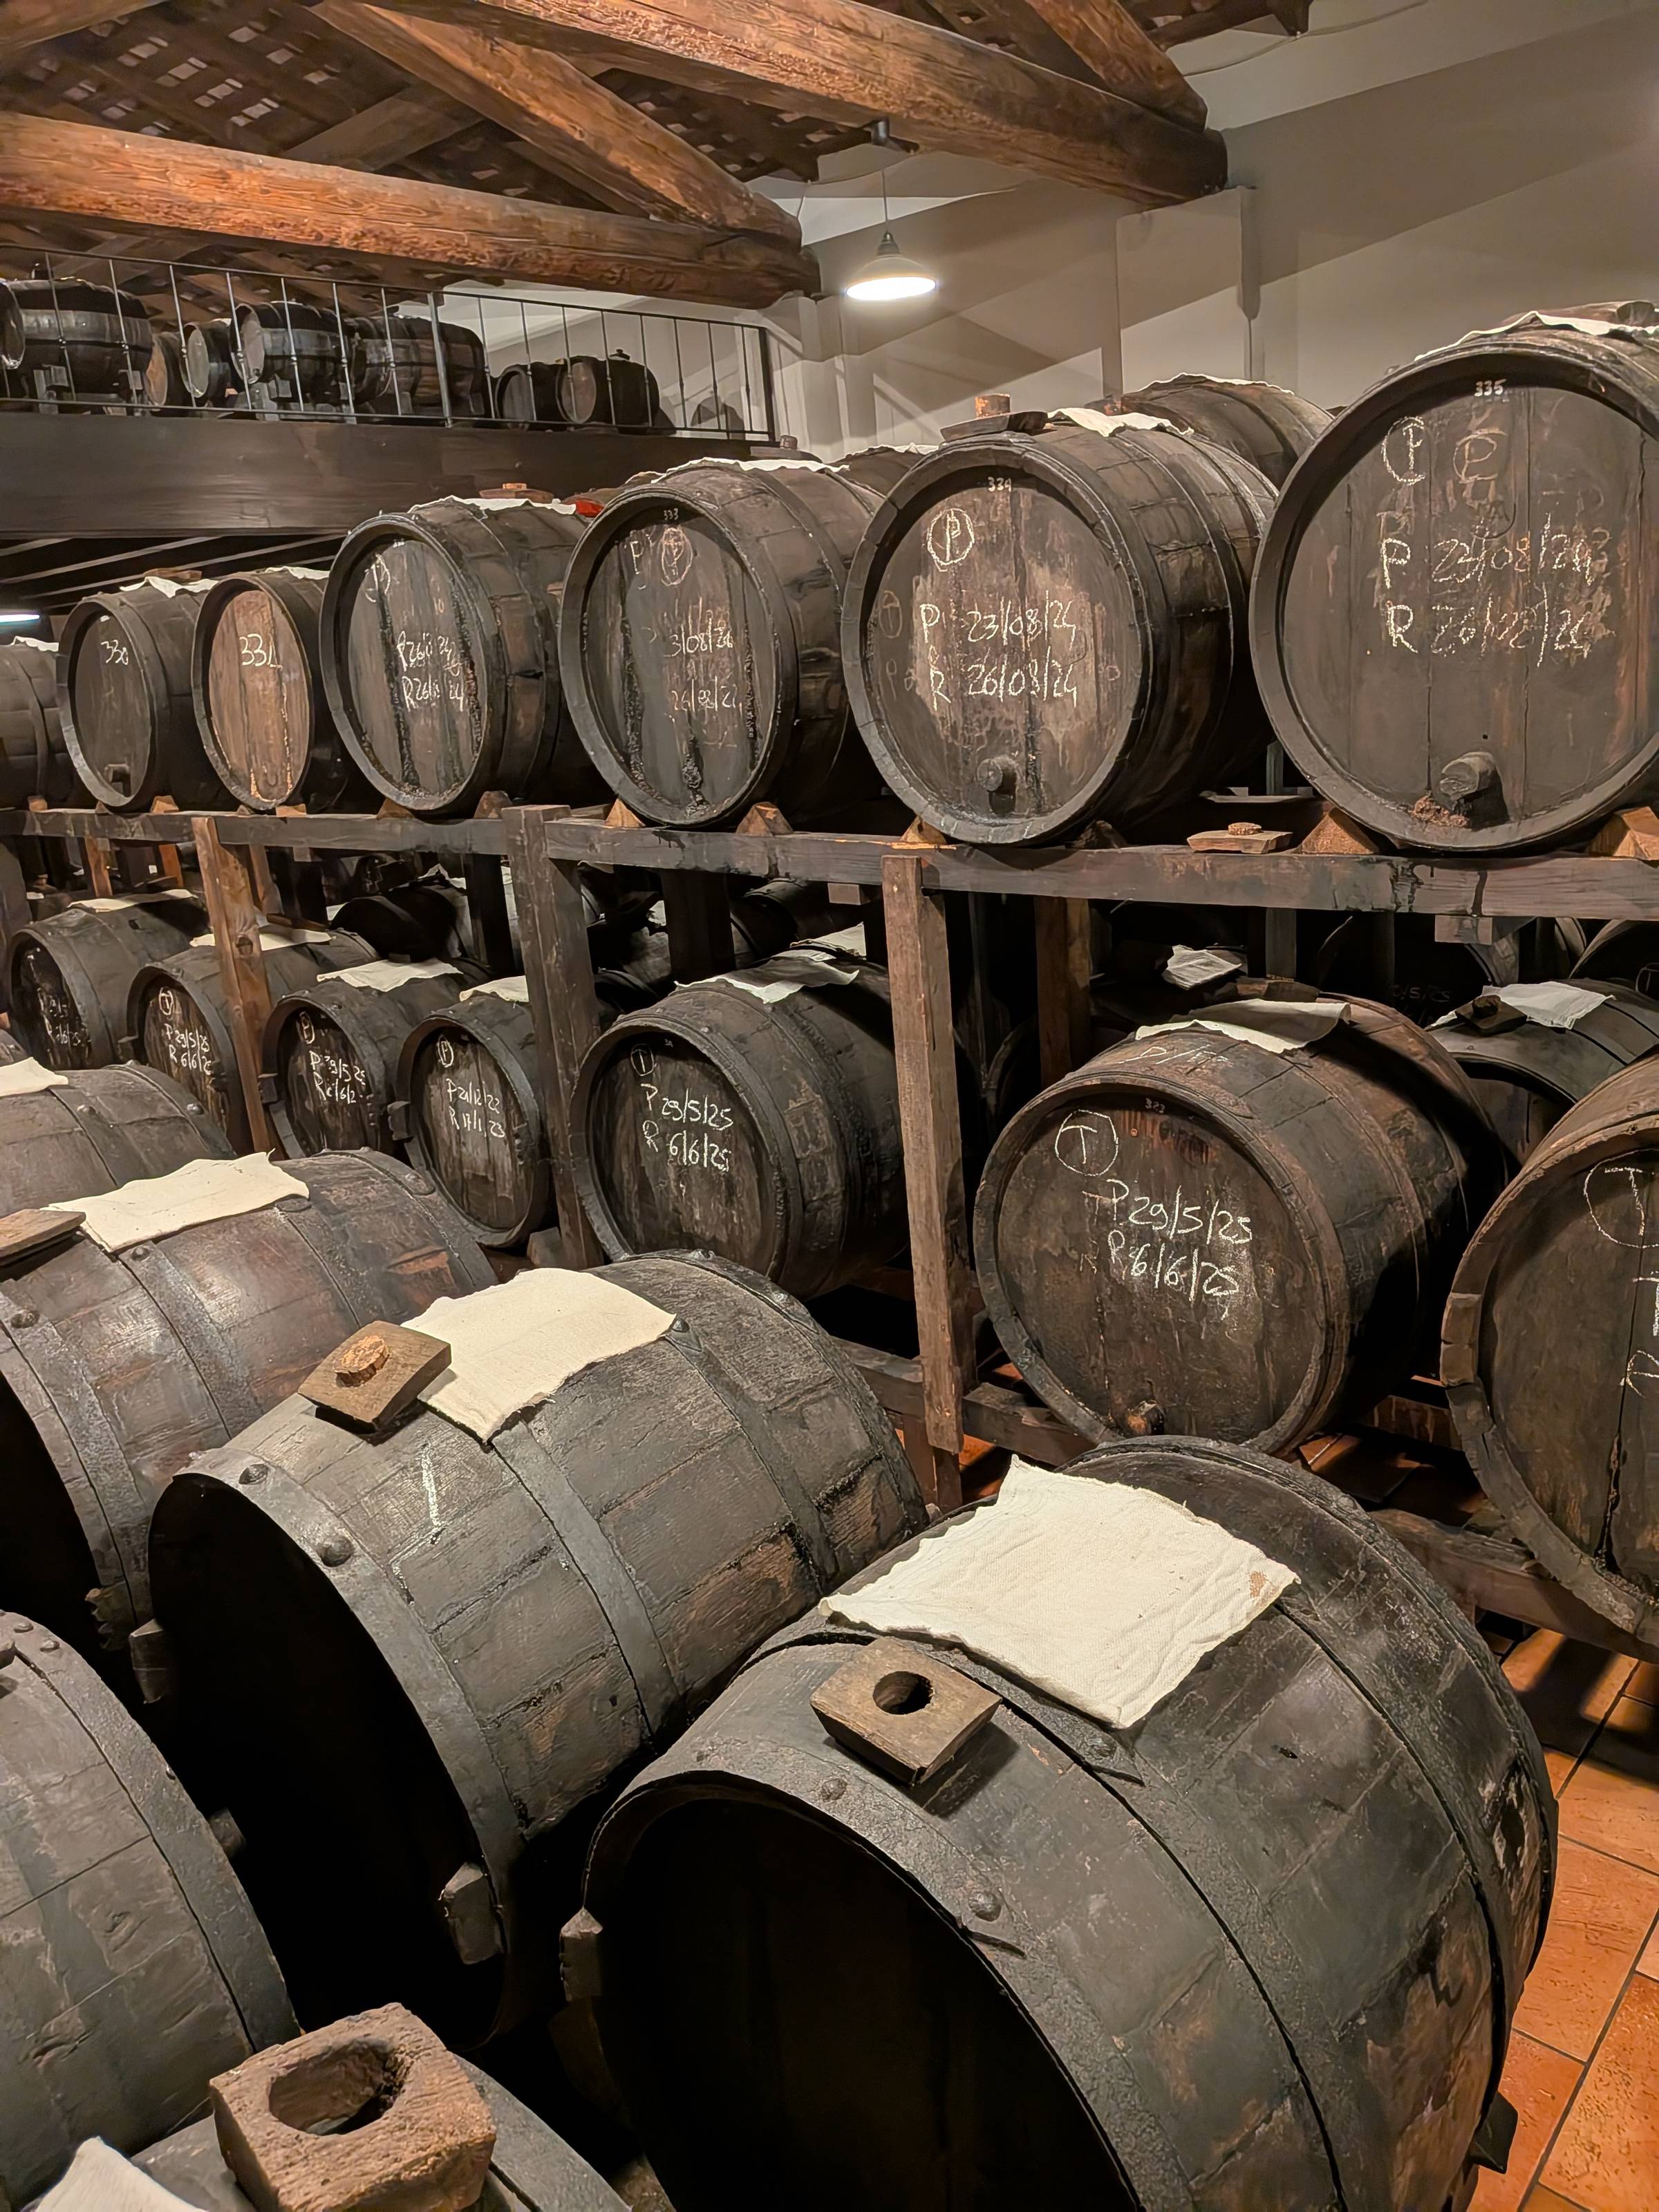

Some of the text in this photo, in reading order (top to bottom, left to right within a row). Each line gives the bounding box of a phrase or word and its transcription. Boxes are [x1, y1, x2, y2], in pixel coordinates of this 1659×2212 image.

[1474, 379, 1507, 397] 335
[1382, 538, 1412, 589] P
[919, 603, 941, 643] P
[309, 1050, 321, 1071] P
[446, 1078, 458, 1102] P
[640, 1082, 734, 1131] P 29/5/25
[668, 1130, 732, 1172] 6/6/25
[1128, 1185, 1253, 1244] 29/5/25
